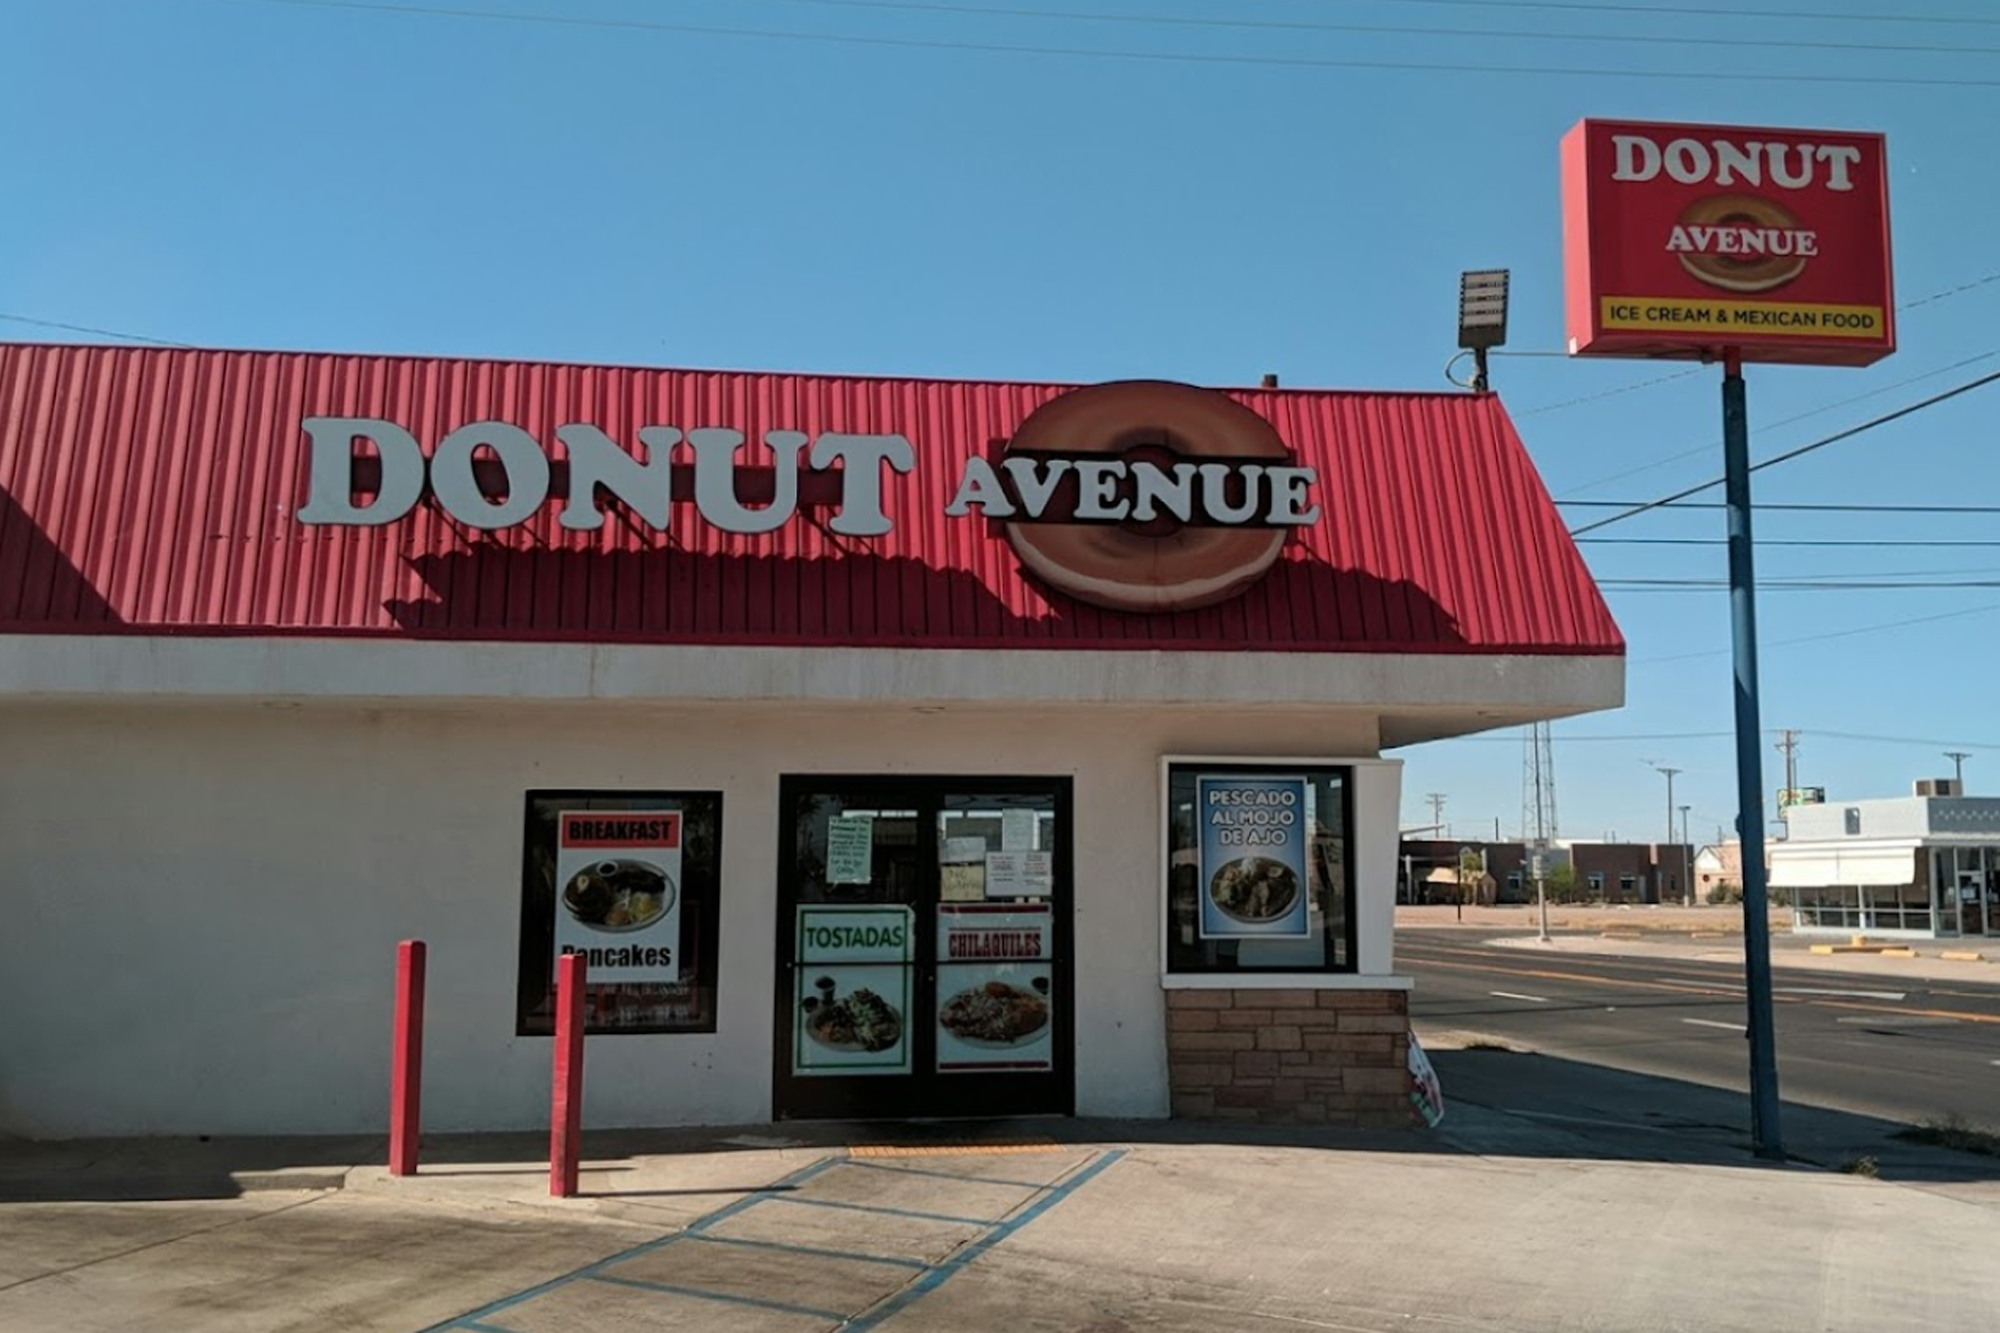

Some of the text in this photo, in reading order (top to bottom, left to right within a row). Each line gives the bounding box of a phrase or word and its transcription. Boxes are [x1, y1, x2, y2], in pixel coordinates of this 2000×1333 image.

[1611, 135, 1861, 191] DONUT
[1665, 225, 1818, 256] AVENUE
[1610, 306, 1875, 329] ICE CREAM & MEXICAN FOOD
[297, 416, 1321, 536] DONUT AVENUE
[1209, 789, 1296, 806] PESCADO
[1211, 810, 1296, 826] AL MOJO
[568, 820, 672, 841] BREAKFAST
[1220, 829, 1286, 845] DE AJO
[806, 926, 903, 948] TOSTADAS
[948, 932, 1041, 958] CHILAQUILES
